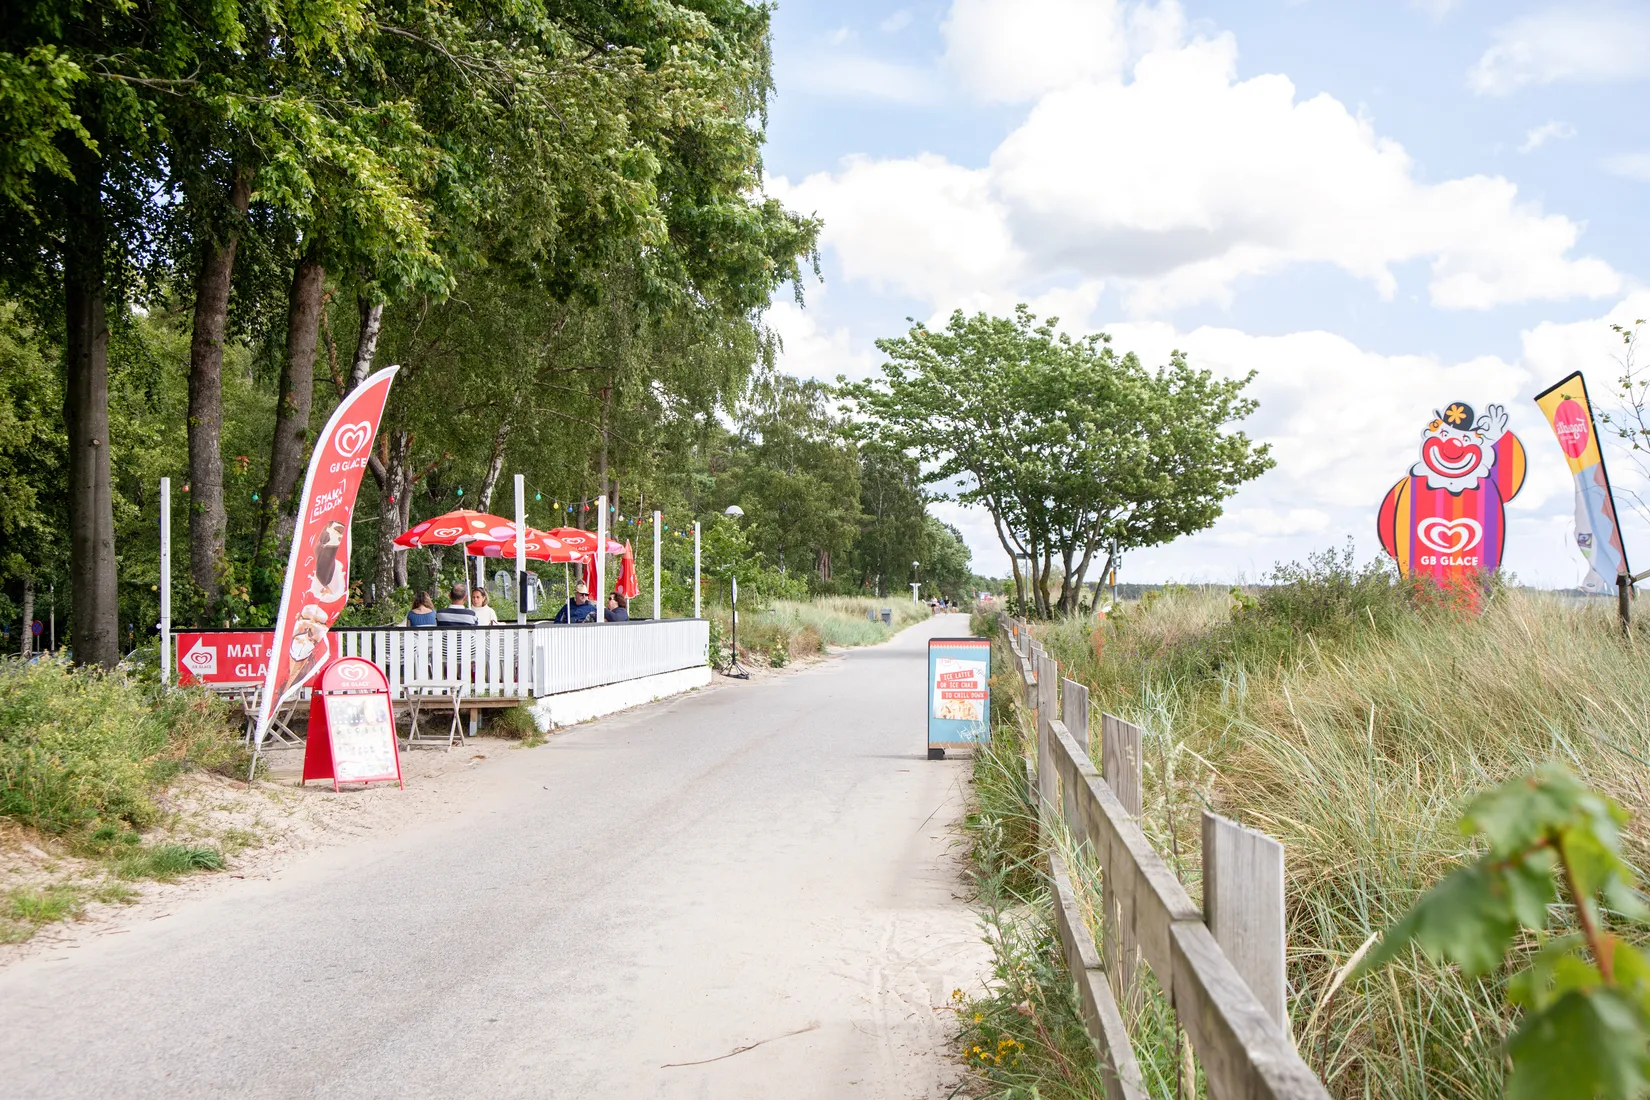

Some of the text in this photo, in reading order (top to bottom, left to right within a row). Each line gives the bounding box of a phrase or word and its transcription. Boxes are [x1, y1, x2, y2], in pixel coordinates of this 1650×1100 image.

[1420, 555, 1479, 566] GB GLACE
[227, 643, 272, 658] MAT &
[234, 663, 269, 677] GLA
[943, 671, 970, 681] ICE LATTE
